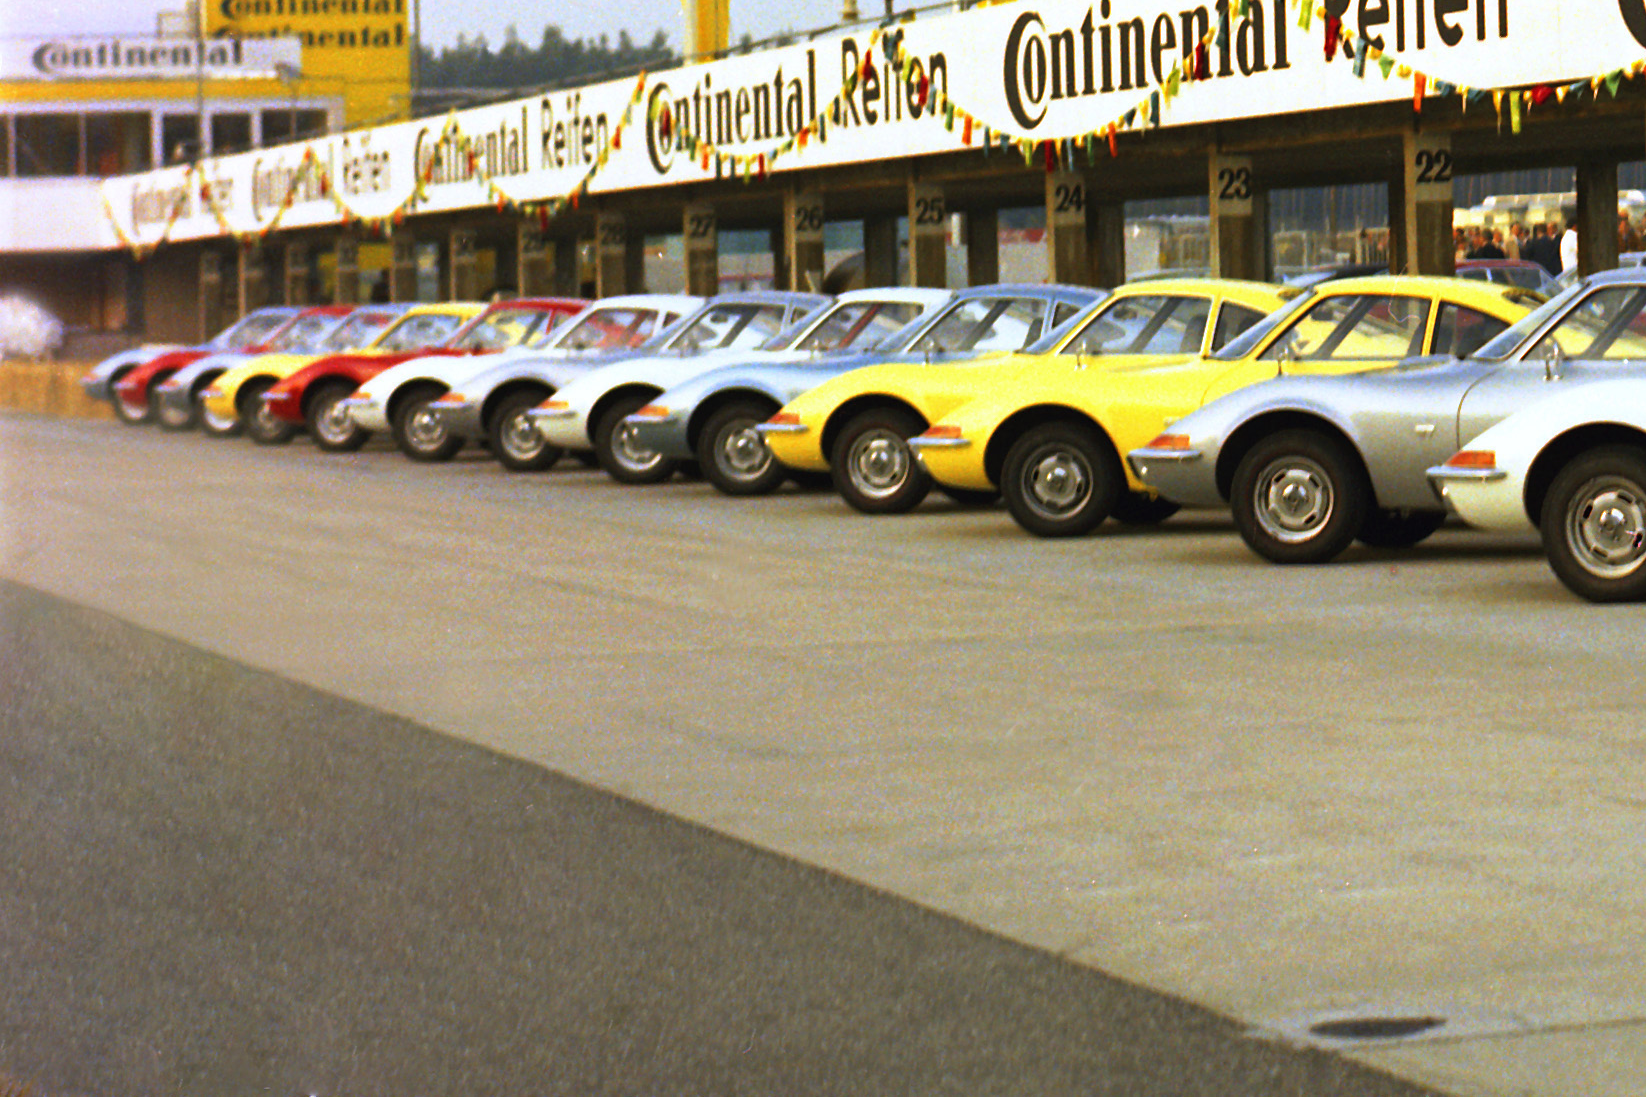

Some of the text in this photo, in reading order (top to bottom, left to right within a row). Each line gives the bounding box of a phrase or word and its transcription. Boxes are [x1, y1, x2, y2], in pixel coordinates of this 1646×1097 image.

[1415, 149, 1452, 183] 22
[1218, 167, 1251, 200] 23
[915, 197, 944, 224] 25
[1055, 184, 1084, 212] 24
[796, 205, 822, 233] 26
